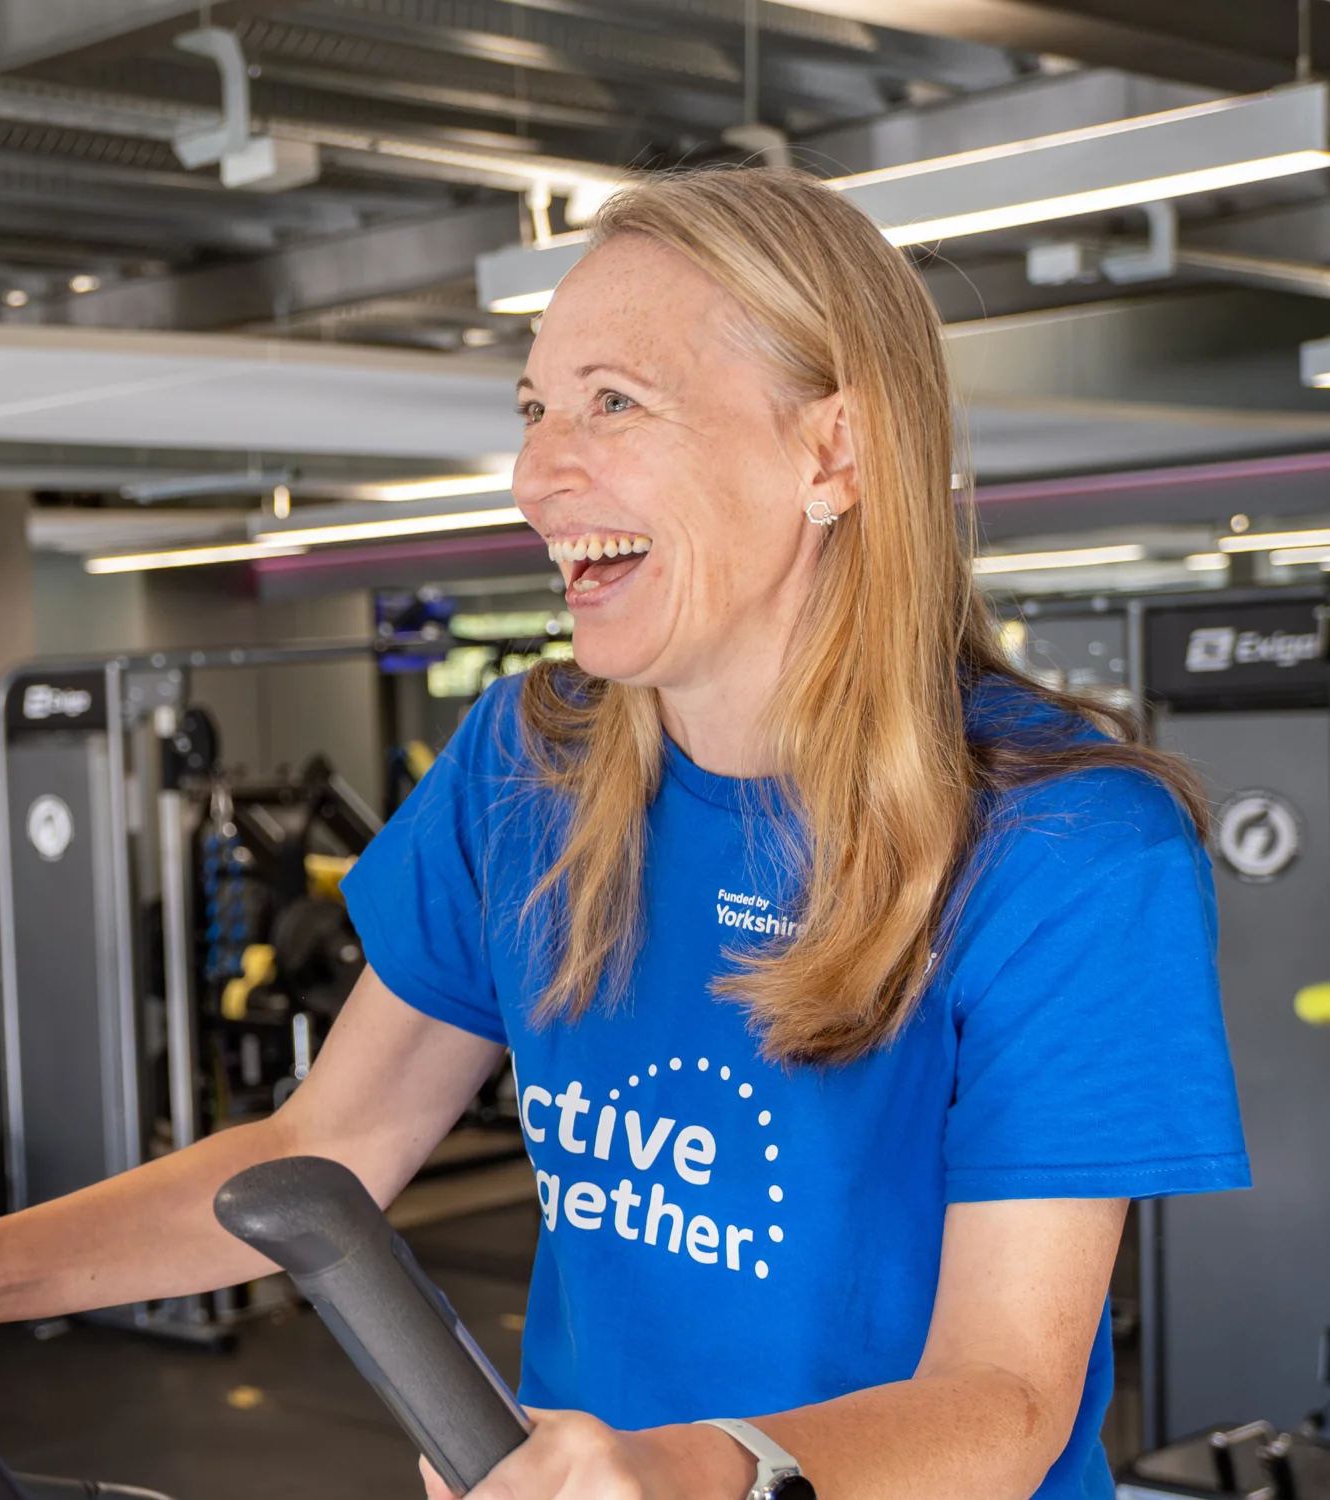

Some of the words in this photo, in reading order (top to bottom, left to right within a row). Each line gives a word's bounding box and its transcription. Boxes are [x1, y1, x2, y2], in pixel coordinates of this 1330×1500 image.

[718, 889, 755, 906] Funded
[755, 896, 770, 911] by
[517, 1080, 716, 1186] ctive
[531, 1169, 769, 1279] gether.
